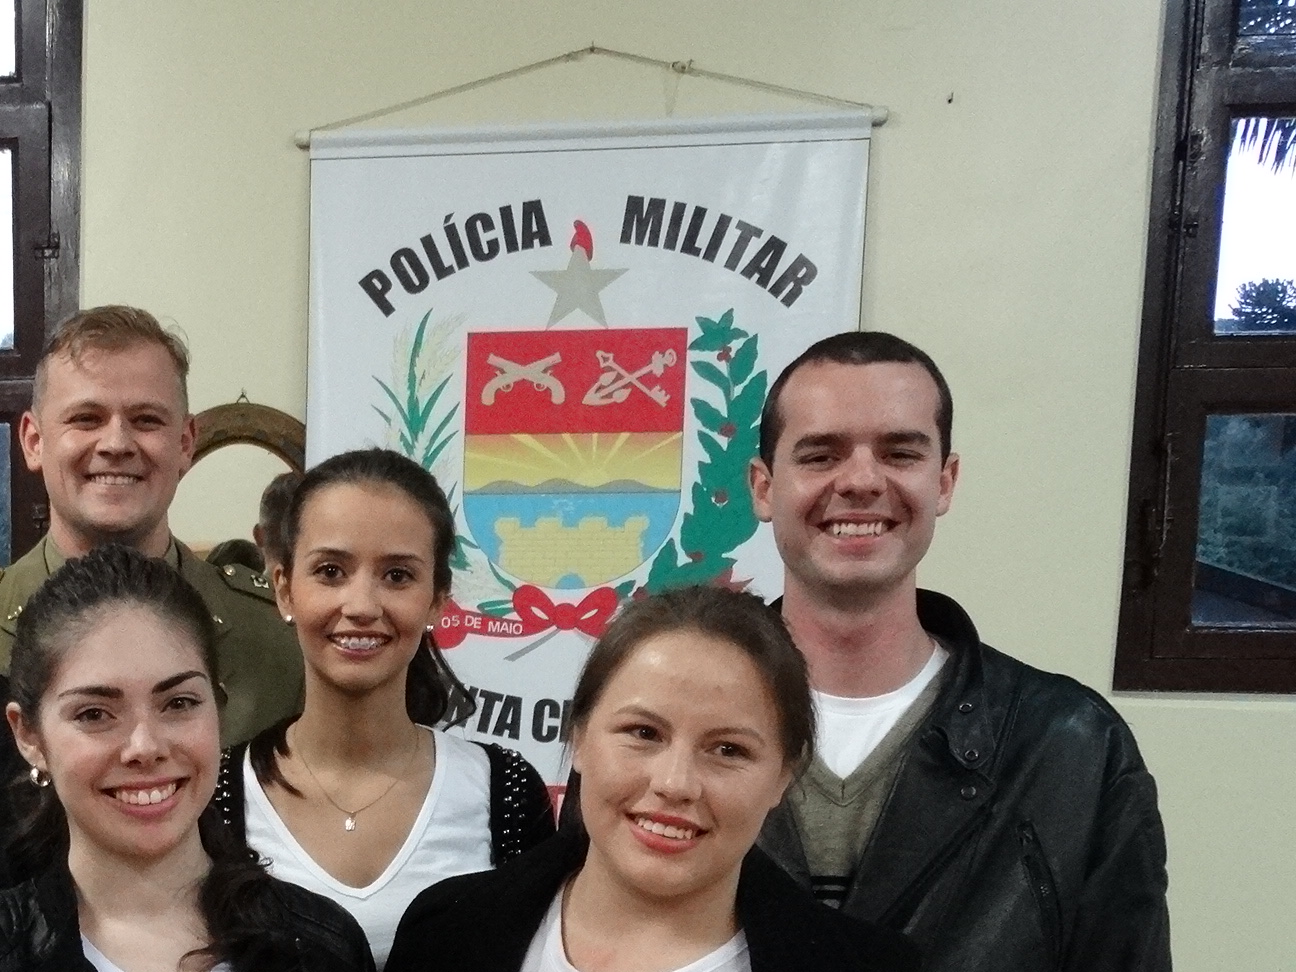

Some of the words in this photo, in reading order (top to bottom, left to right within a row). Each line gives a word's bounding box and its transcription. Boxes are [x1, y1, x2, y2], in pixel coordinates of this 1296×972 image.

[357, 199, 553, 318] POLÍCIA
[619, 194, 819, 308] MILITAR
[441, 614, 460, 629] 05
[464, 615, 482, 629] DE
[487, 620, 523, 635] MAIO
